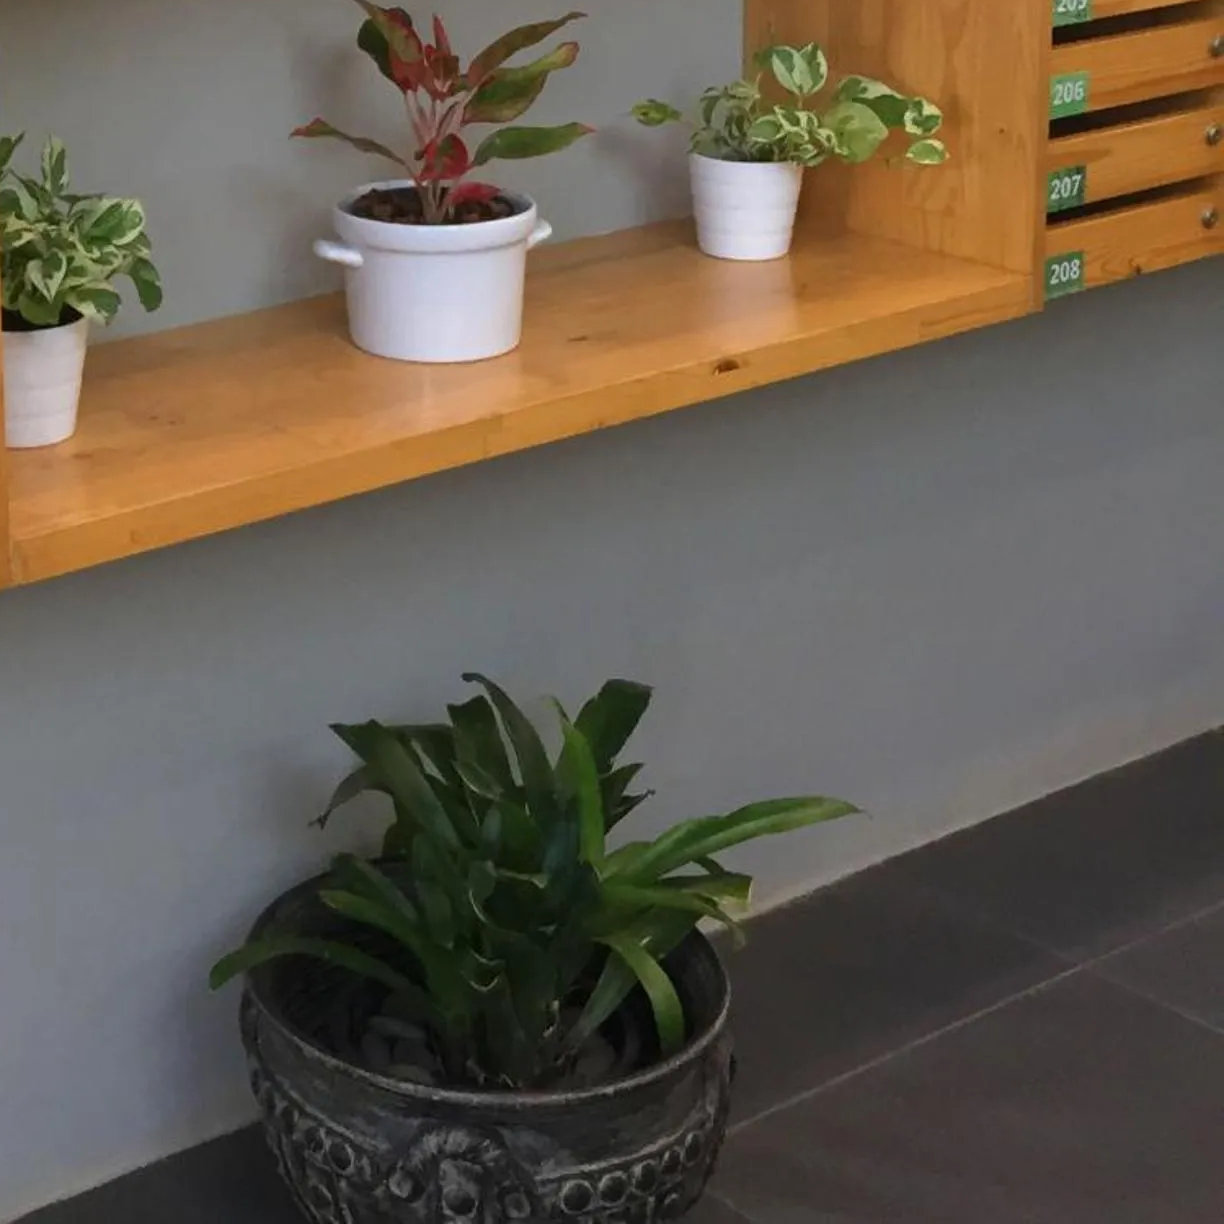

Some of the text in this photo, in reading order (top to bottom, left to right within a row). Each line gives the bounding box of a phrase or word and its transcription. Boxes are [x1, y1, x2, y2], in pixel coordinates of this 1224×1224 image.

[1053, 80, 1084, 105] 206
[1051, 175, 1082, 200] 207
[1050, 259, 1080, 284] 208
